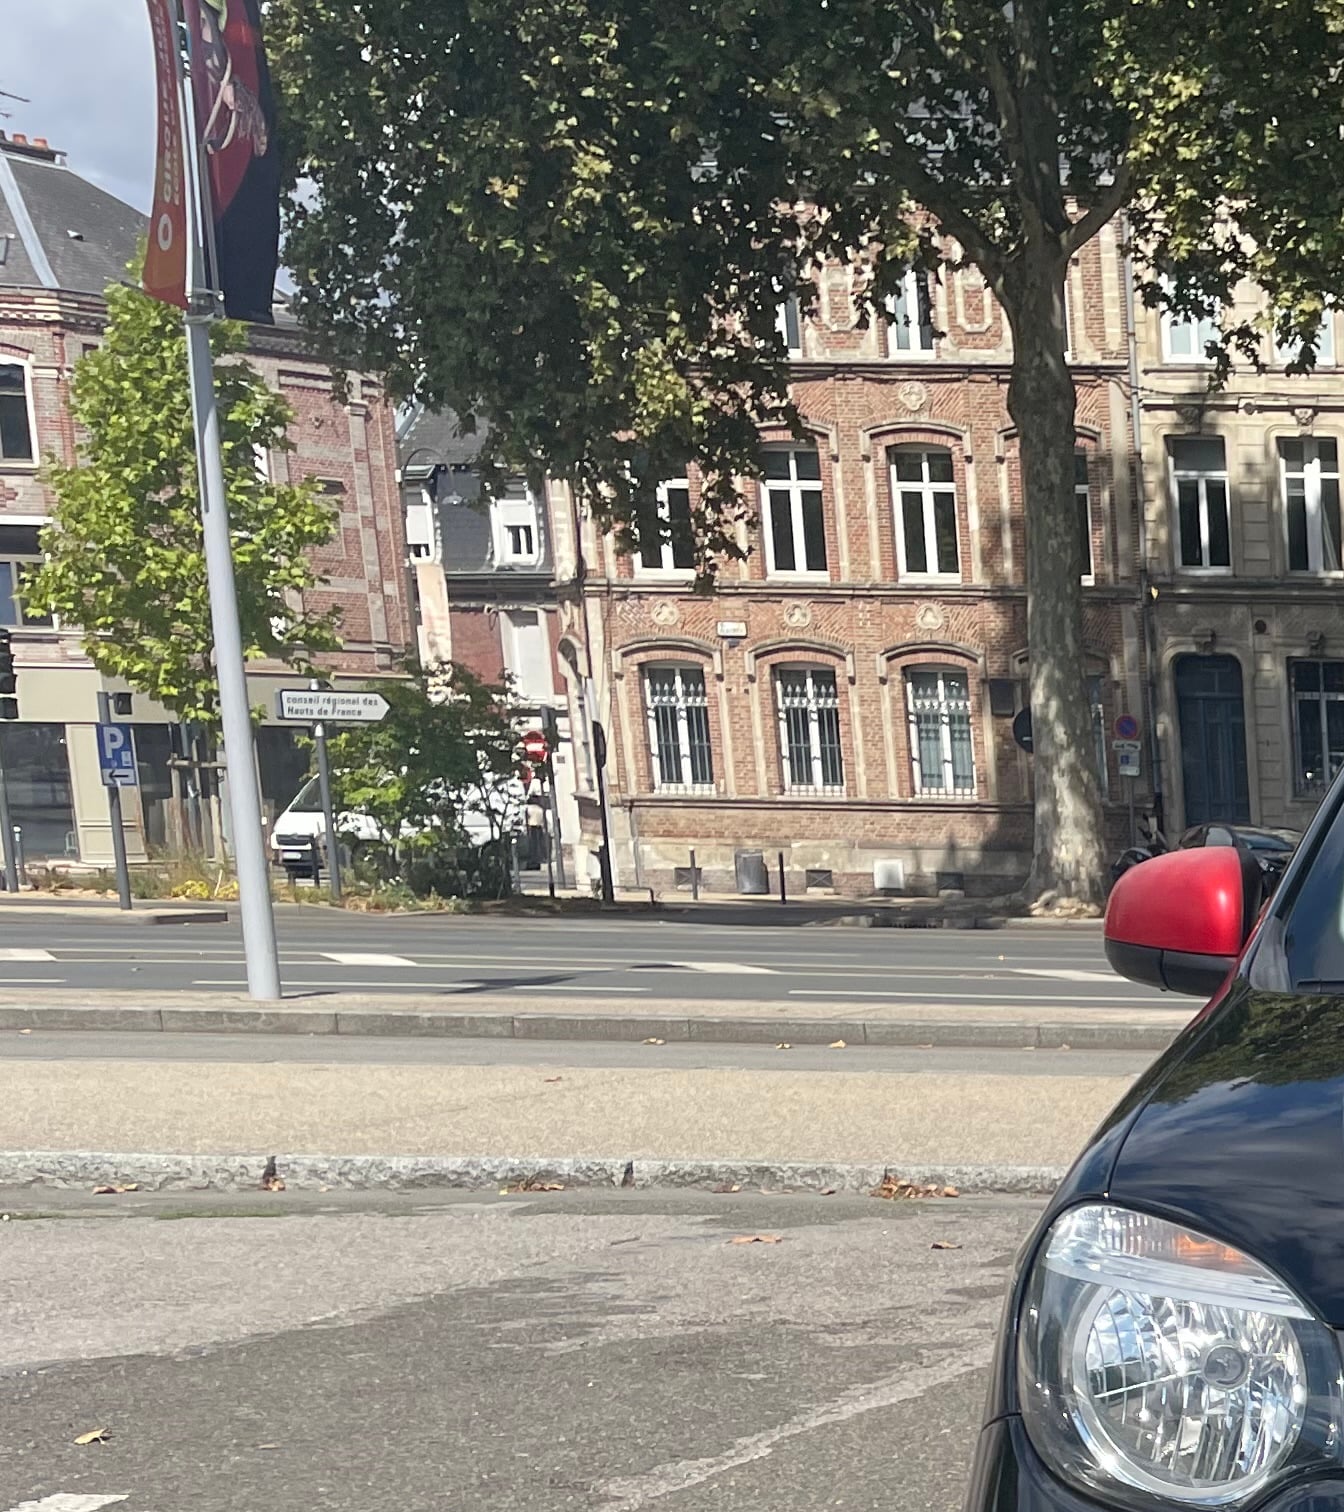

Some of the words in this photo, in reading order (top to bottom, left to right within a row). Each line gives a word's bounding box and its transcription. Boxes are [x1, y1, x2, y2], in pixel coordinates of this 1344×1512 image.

[286, 695, 320, 705] conseil
[322, 695, 360, 707] régional
[362, 696, 379, 706] des
[287, 705, 314, 716] Hauts
[317, 706, 328, 716] de
[102, 727, 124, 759] P
